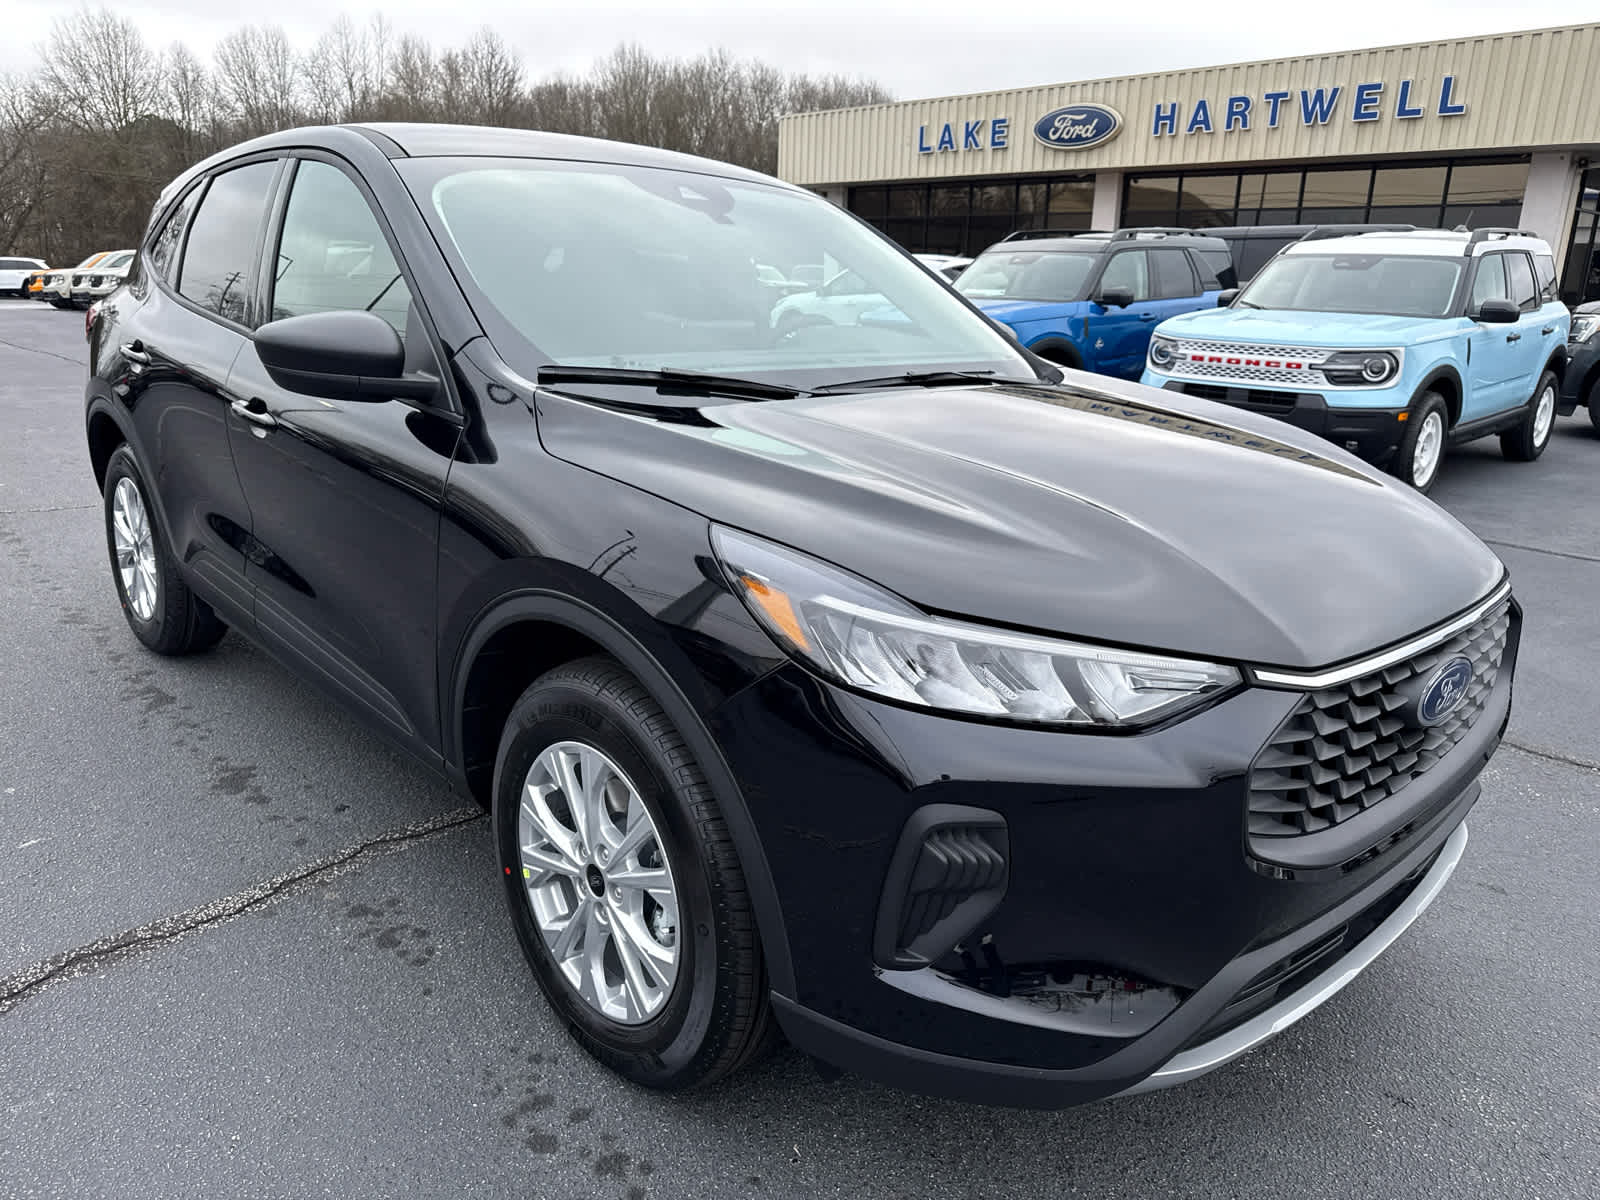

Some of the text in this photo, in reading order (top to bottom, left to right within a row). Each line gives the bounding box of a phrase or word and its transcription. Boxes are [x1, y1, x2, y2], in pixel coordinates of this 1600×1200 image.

[918, 76, 1467, 155] LAKE Ford HARTWELL
[1191, 355, 1302, 369] BRONCO
[1434, 672, 1466, 714] Ford
